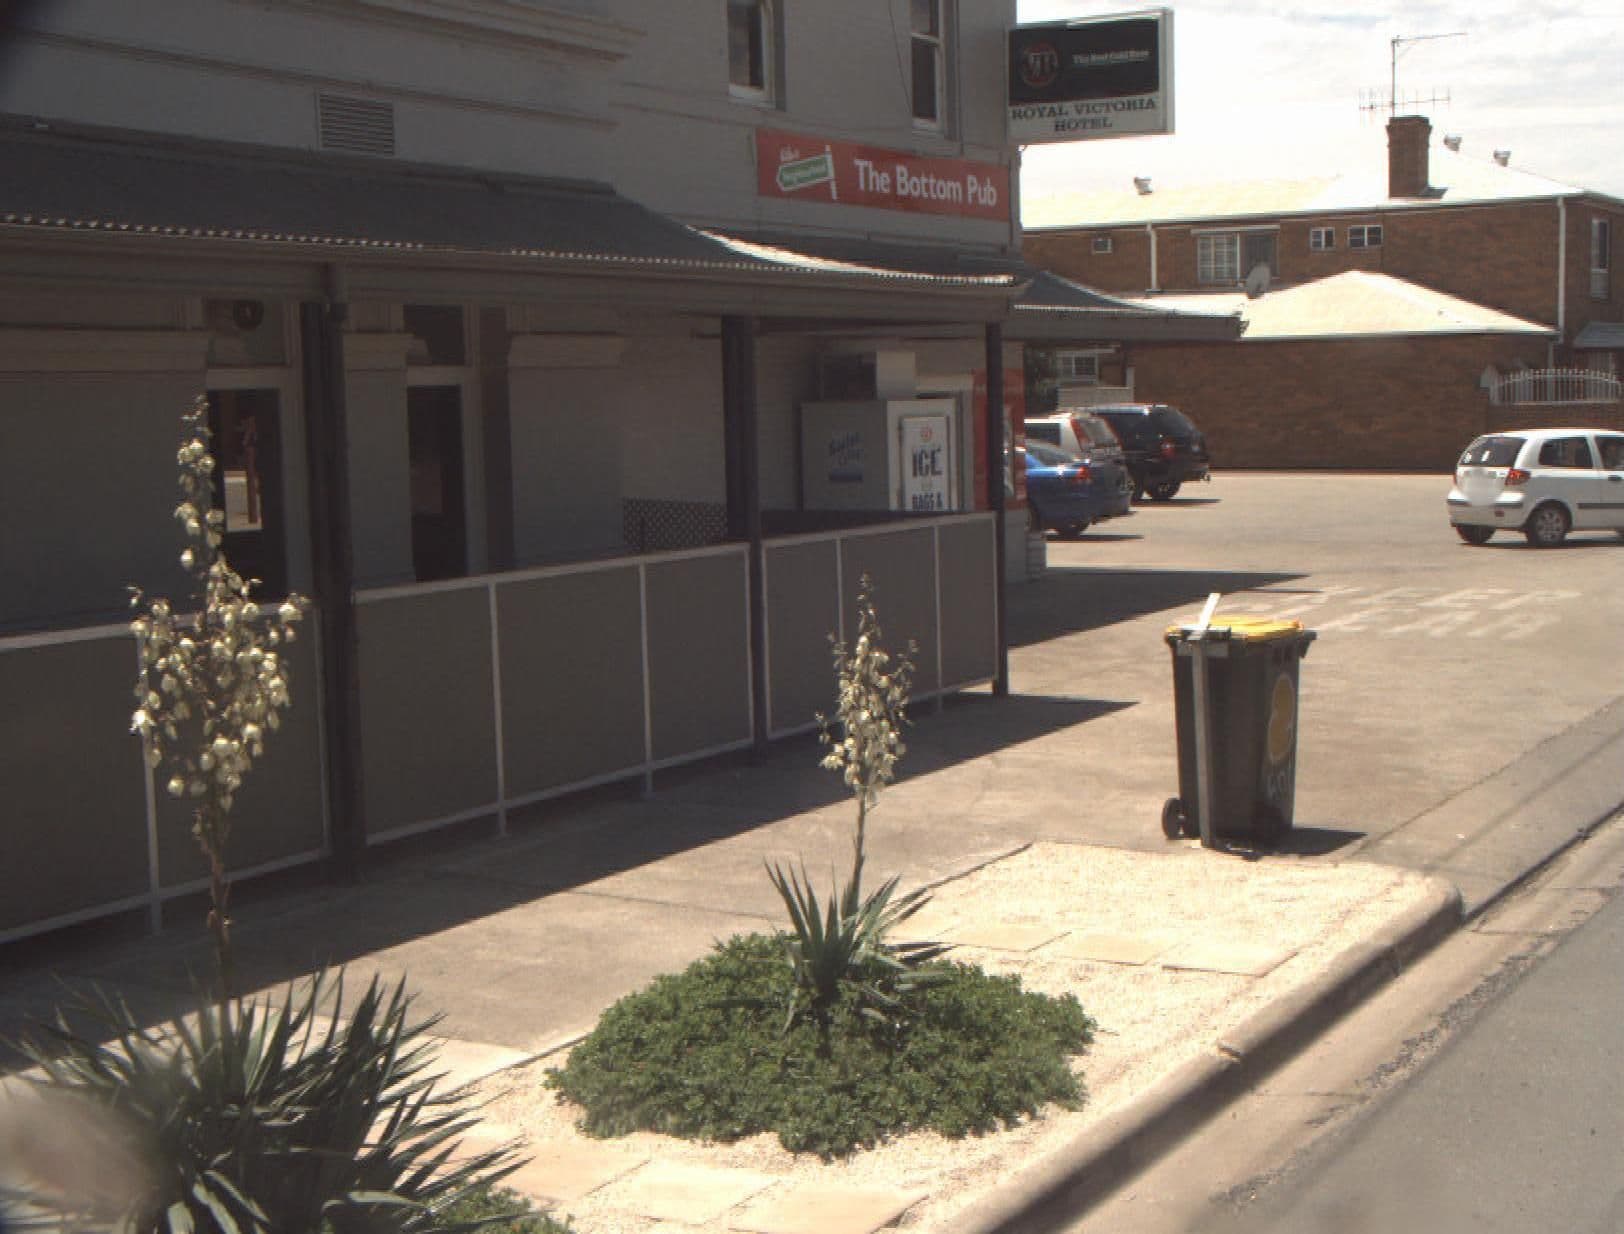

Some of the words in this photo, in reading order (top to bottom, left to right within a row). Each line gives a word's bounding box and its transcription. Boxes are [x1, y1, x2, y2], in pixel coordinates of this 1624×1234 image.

[1012, 104, 1068, 120] ROYAL
[1074, 98, 1155, 115] VICTORIA
[1054, 117, 1112, 132] HOTEL
[853, 158, 890, 194] The
[895, 165, 963, 202] Bottom
[967, 174, 998, 207] Pub
[912, 448, 943, 478] ICE
